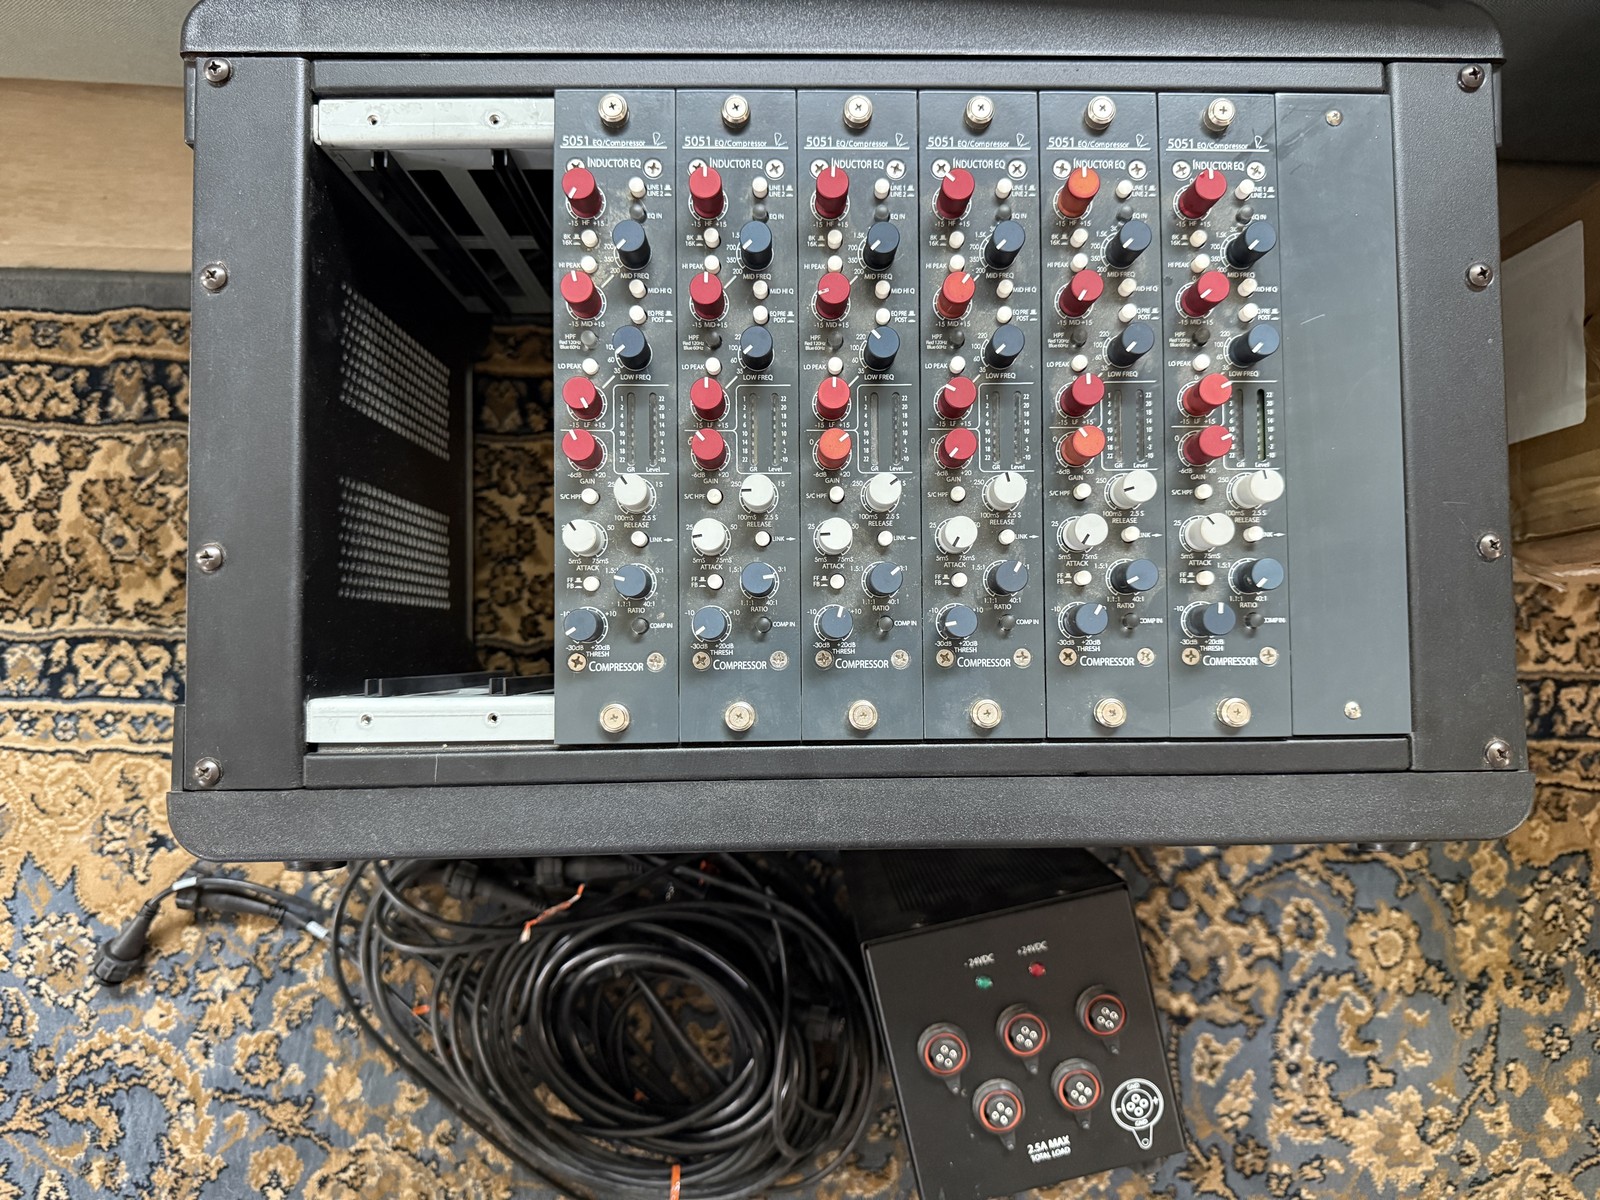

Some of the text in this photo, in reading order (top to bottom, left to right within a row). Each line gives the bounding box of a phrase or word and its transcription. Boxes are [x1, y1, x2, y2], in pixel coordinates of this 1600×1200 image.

[563, 137, 589, 146] 5051
[685, 137, 711, 146] 5051
[806, 137, 832, 147] 5051
[928, 137, 954, 147] 5051
[1048, 138, 1074, 147] 5051
[1168, 139, 1248, 150] 5051 EQ/Compressor
[588, 157, 641, 169] INDUCTOR EQ
[710, 158, 762, 169] INDUCTOR EQ
[831, 158, 884, 169] INDUCTOR EQ
[953, 158, 1005, 169] INDUCTOR EQ
[1115, 160, 1125, 170] EQ
[1234, 161, 1244, 171] EQ
[589, 661, 643, 672] COMPRESSOR
[713, 660, 767, 670] COMPRESSOR
[835, 658, 889, 669] COMPRESSOR
[957, 657, 1011, 667] COMPRESSOR
[1027, 1135, 1070, 1155] 2.5A MAX
[1031, 1146, 1071, 1164] TOTAL LOAD
